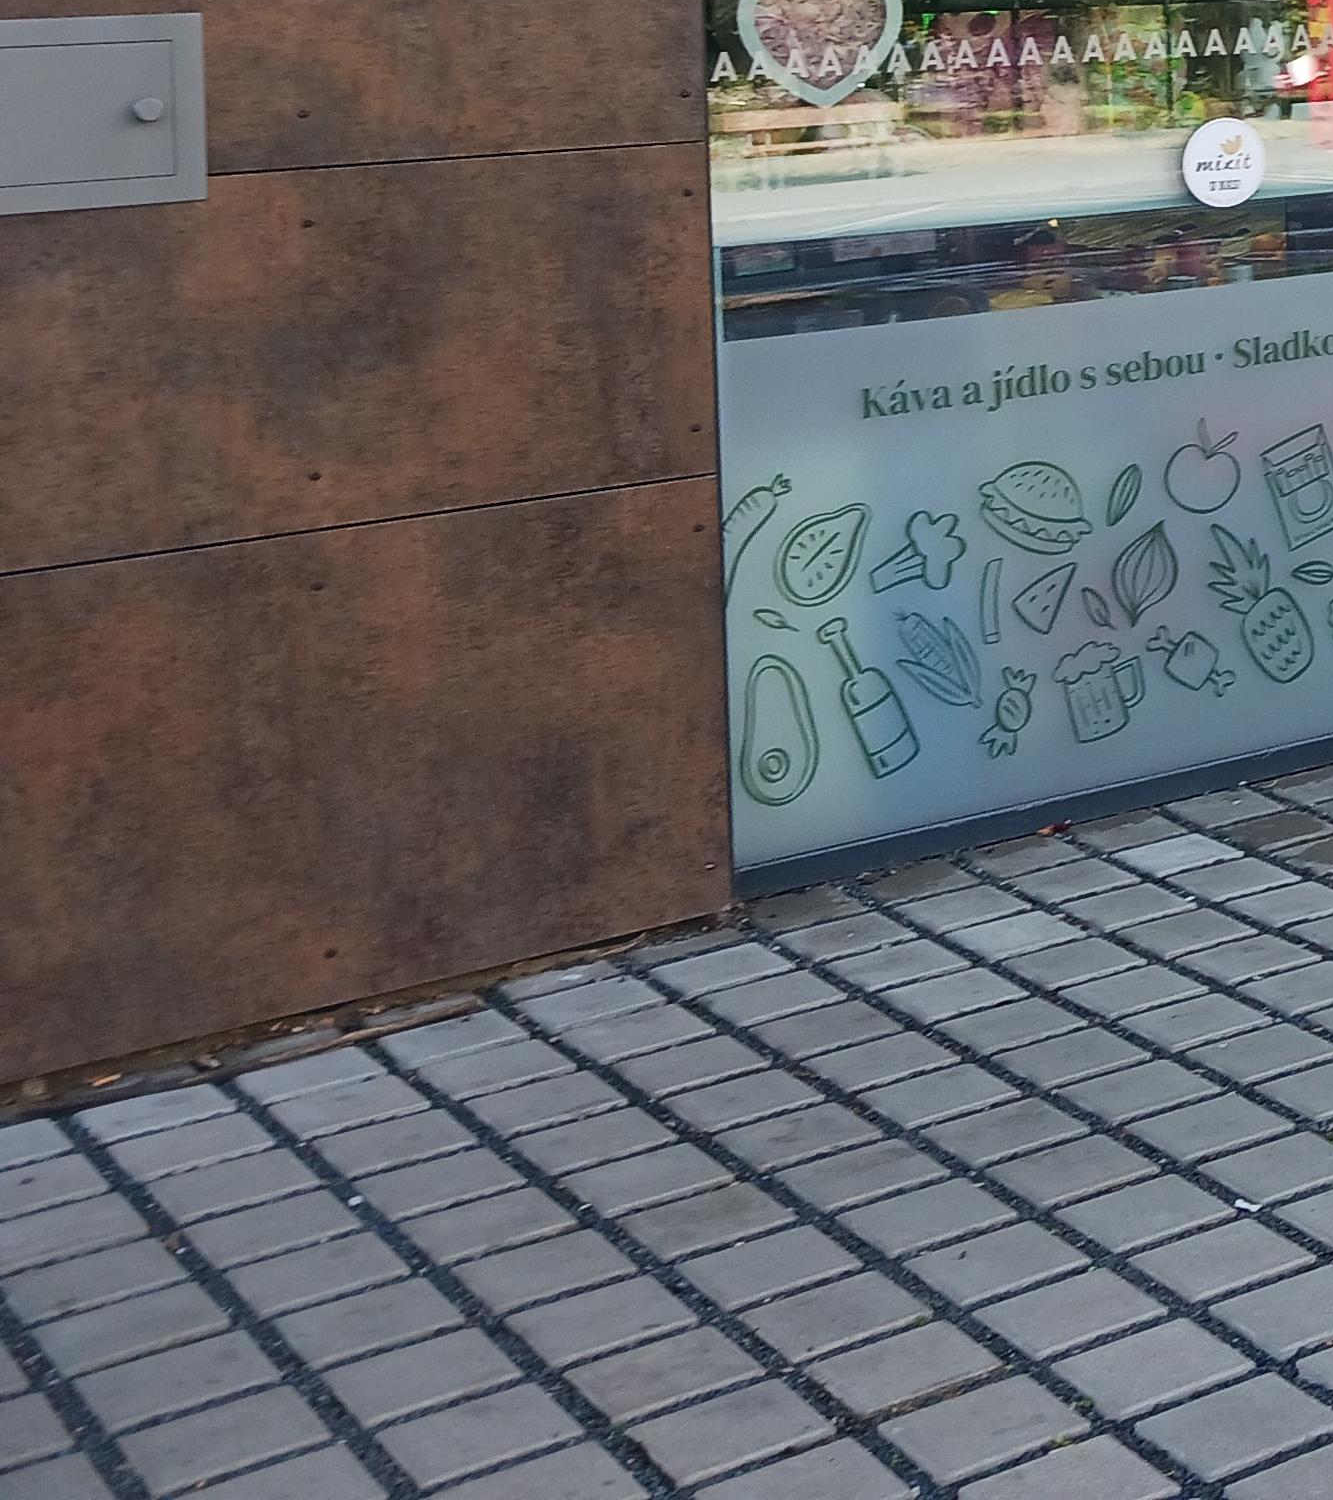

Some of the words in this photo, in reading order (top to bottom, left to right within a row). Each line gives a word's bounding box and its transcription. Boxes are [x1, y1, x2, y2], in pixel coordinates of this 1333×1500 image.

[860, 379, 950, 420] Káva
[961, 383, 983, 406] a
[986, 361, 1070, 412] jídlo
[1079, 367, 1097, 391] s
[1104, 349, 1208, 386] sebou
